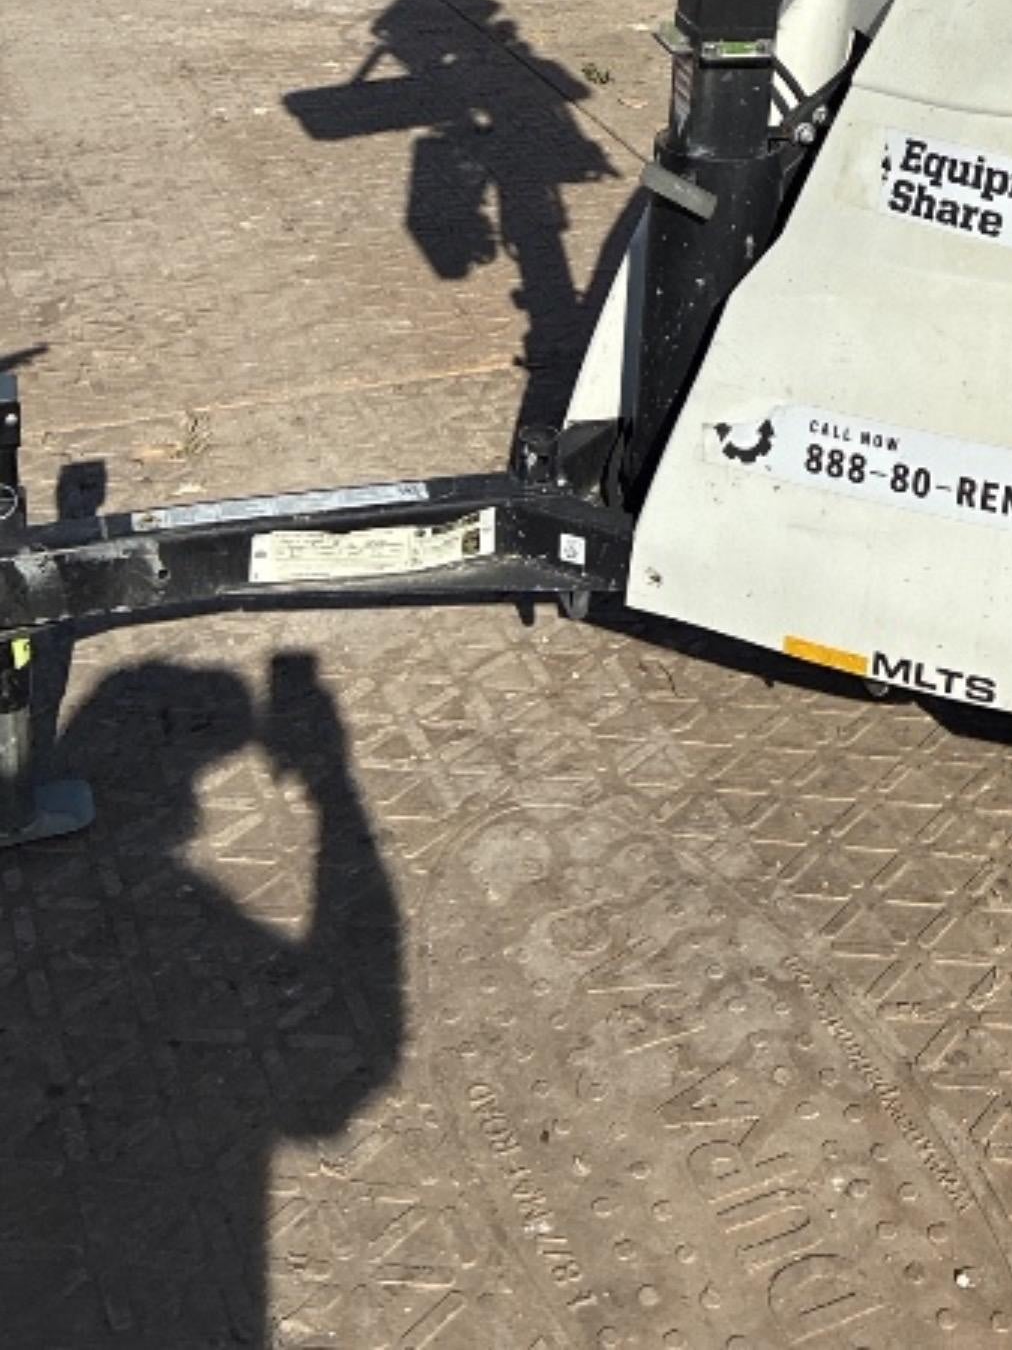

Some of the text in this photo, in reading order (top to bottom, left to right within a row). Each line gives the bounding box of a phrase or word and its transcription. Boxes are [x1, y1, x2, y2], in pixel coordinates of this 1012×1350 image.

[888, 179, 1003, 238] Share
[808, 419, 900, 451] CALL NOW
[872, 650, 997, 703] MLTS
